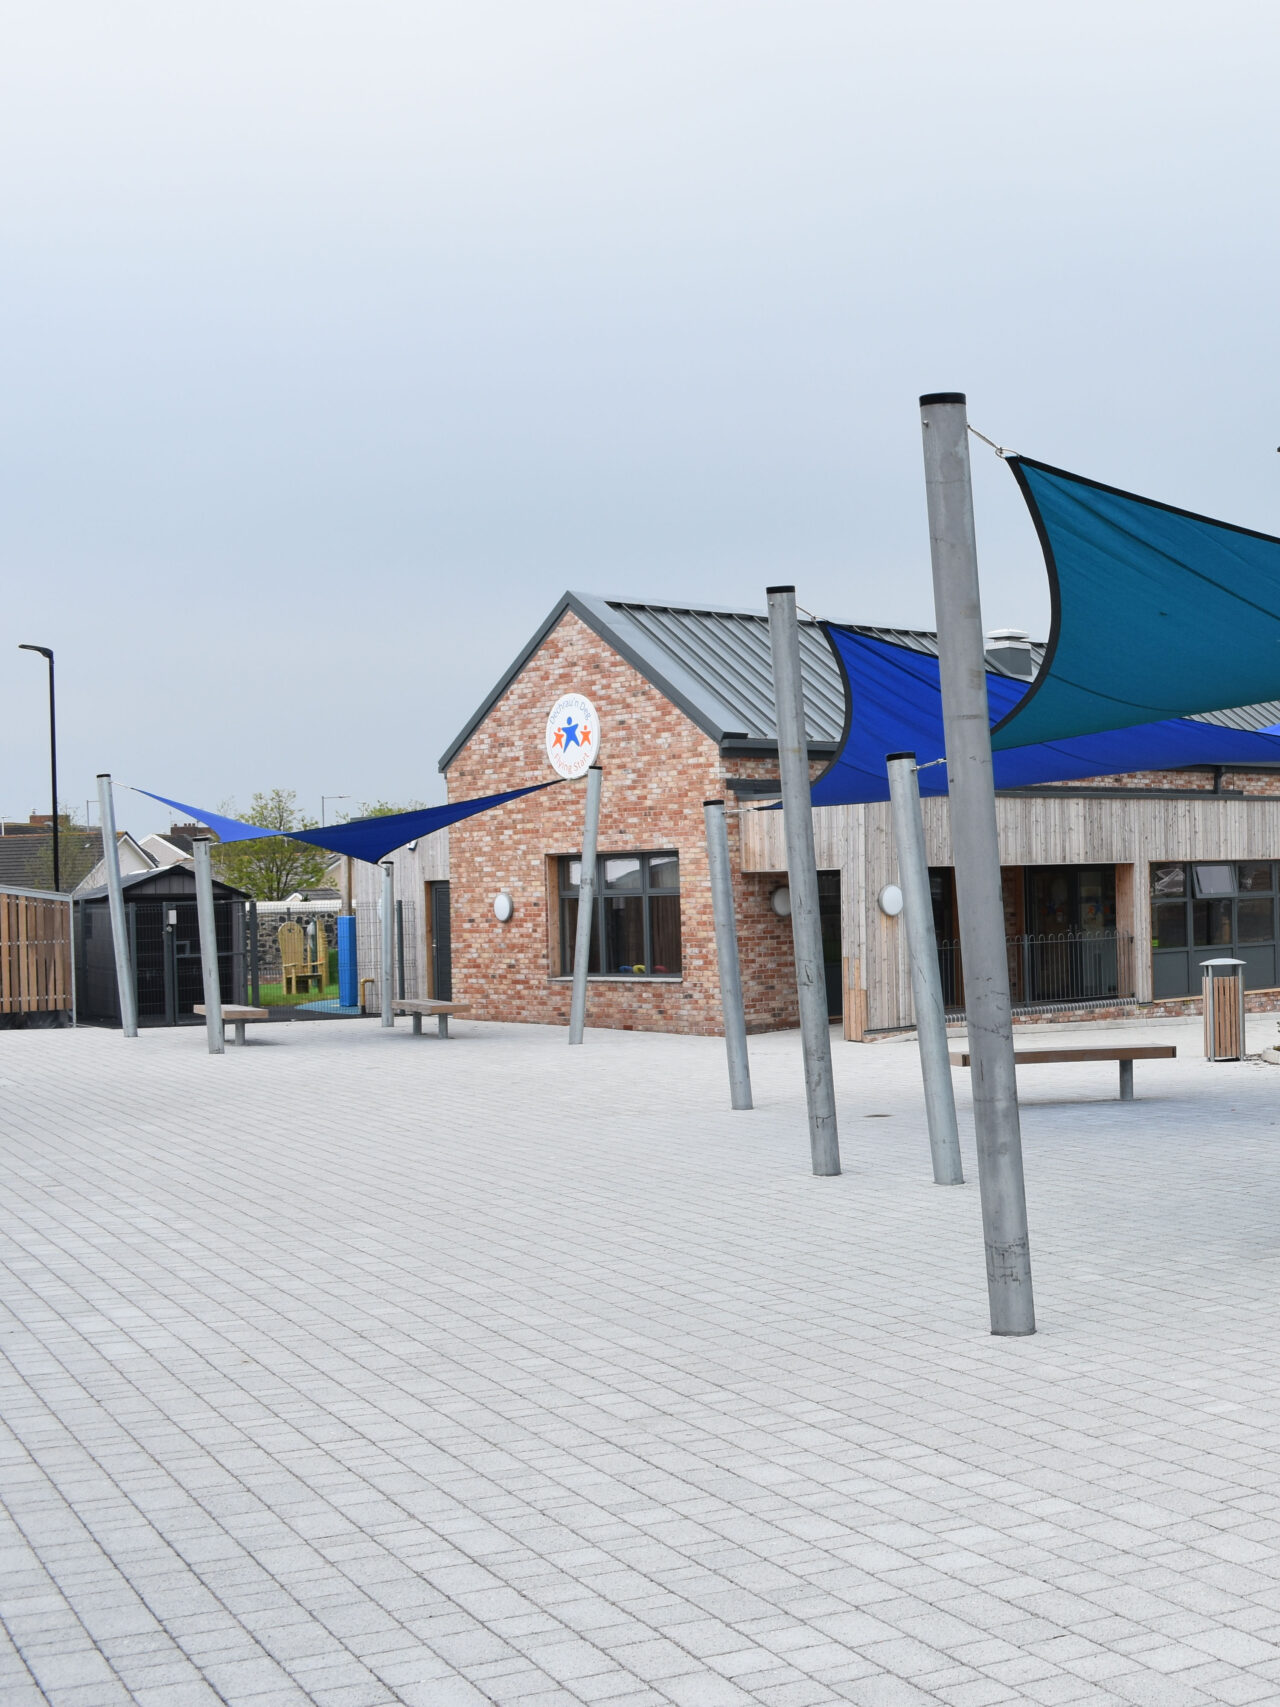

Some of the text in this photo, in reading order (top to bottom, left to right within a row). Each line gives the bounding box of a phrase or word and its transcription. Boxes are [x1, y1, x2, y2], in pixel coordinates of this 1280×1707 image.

[549, 697, 591, 724] Dechrau'n Deg
[553, 752, 590, 774] Flying Start
